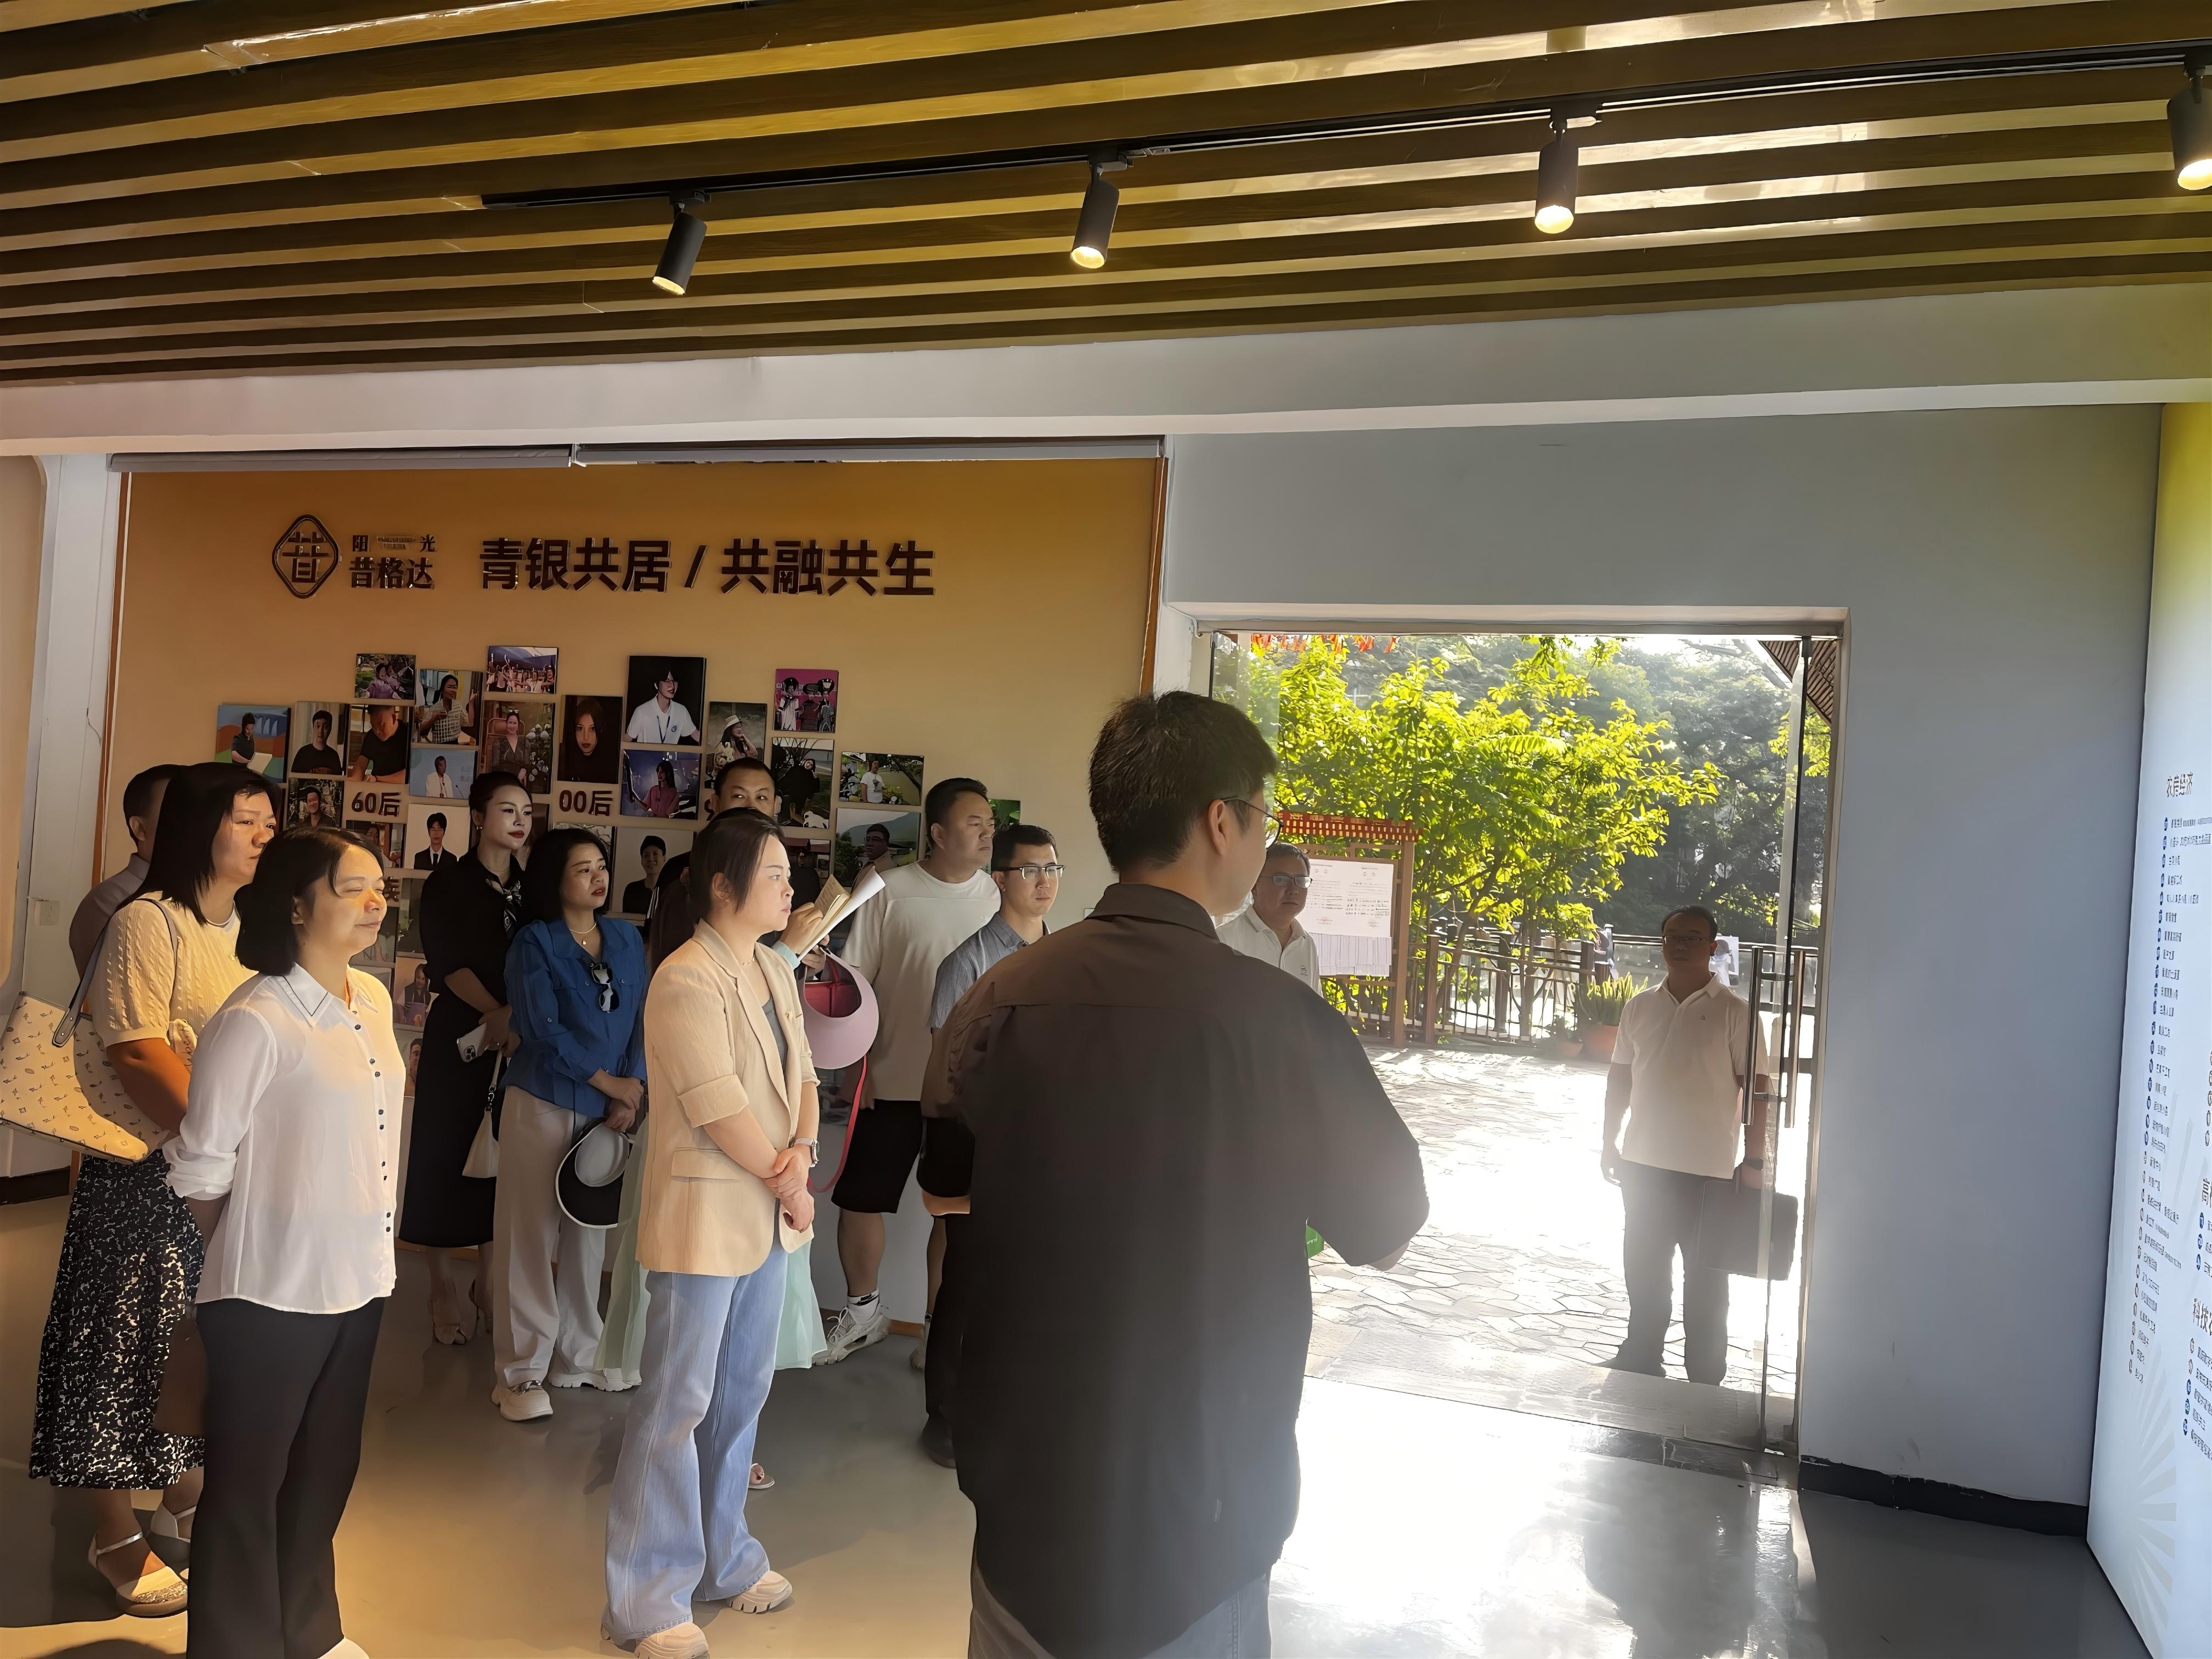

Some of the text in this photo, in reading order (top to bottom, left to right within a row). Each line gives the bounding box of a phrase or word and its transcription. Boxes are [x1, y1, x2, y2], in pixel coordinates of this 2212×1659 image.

[420, 534, 436, 552] 光
[479, 537, 935, 596] 青银共居 / 共融共生
[351, 791, 402, 817] 60后
[559, 789, 613, 816] 00后
